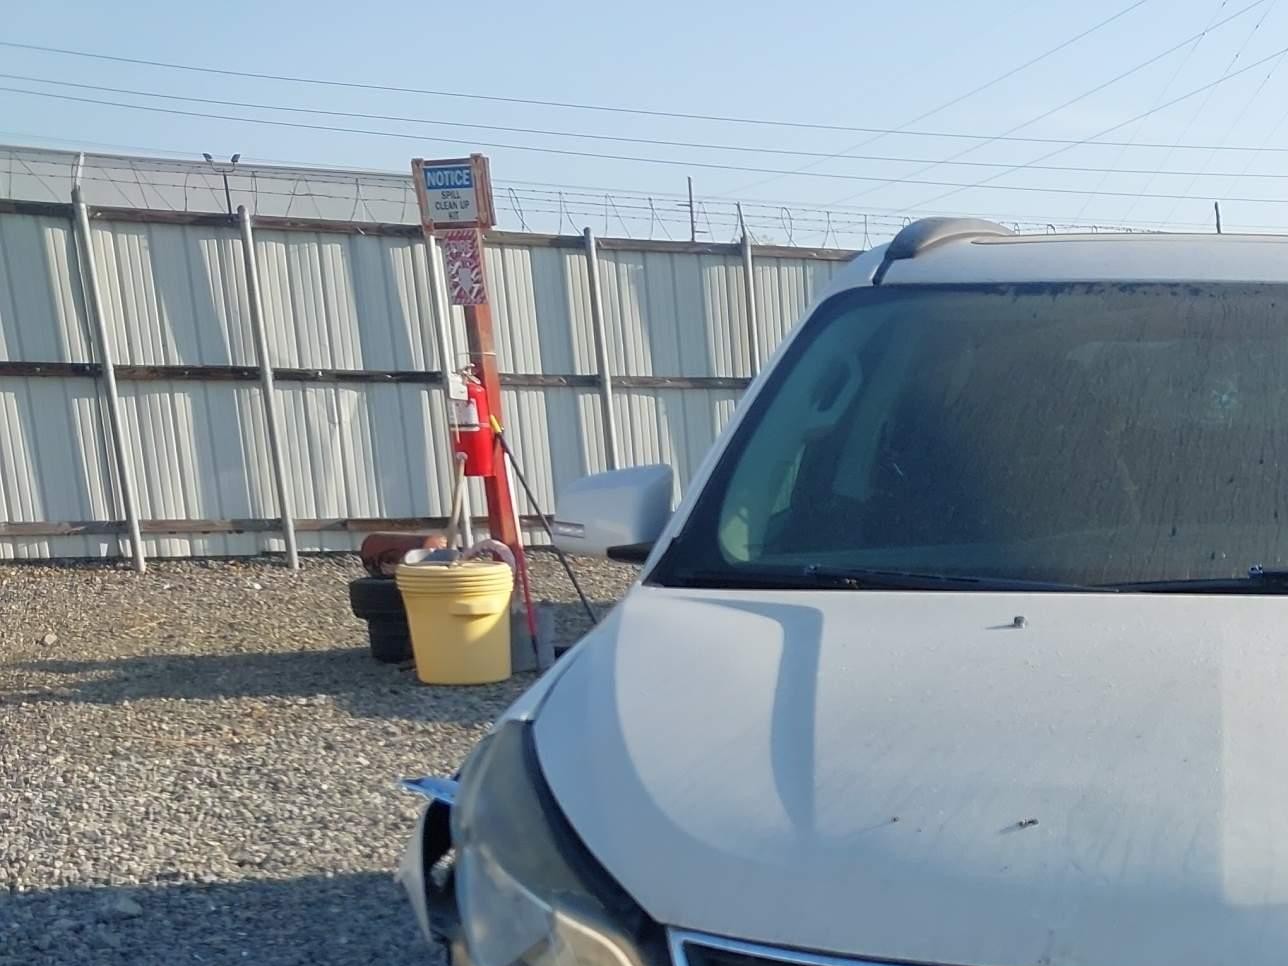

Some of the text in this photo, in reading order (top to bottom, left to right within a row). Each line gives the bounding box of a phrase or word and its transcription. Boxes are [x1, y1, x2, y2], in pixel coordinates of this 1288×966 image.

[426, 169, 471, 187] NOTICE
[441, 190, 461, 200] SPILL
[435, 200, 470, 211] CLEAN UP
[449, 211, 459, 219] KIT
